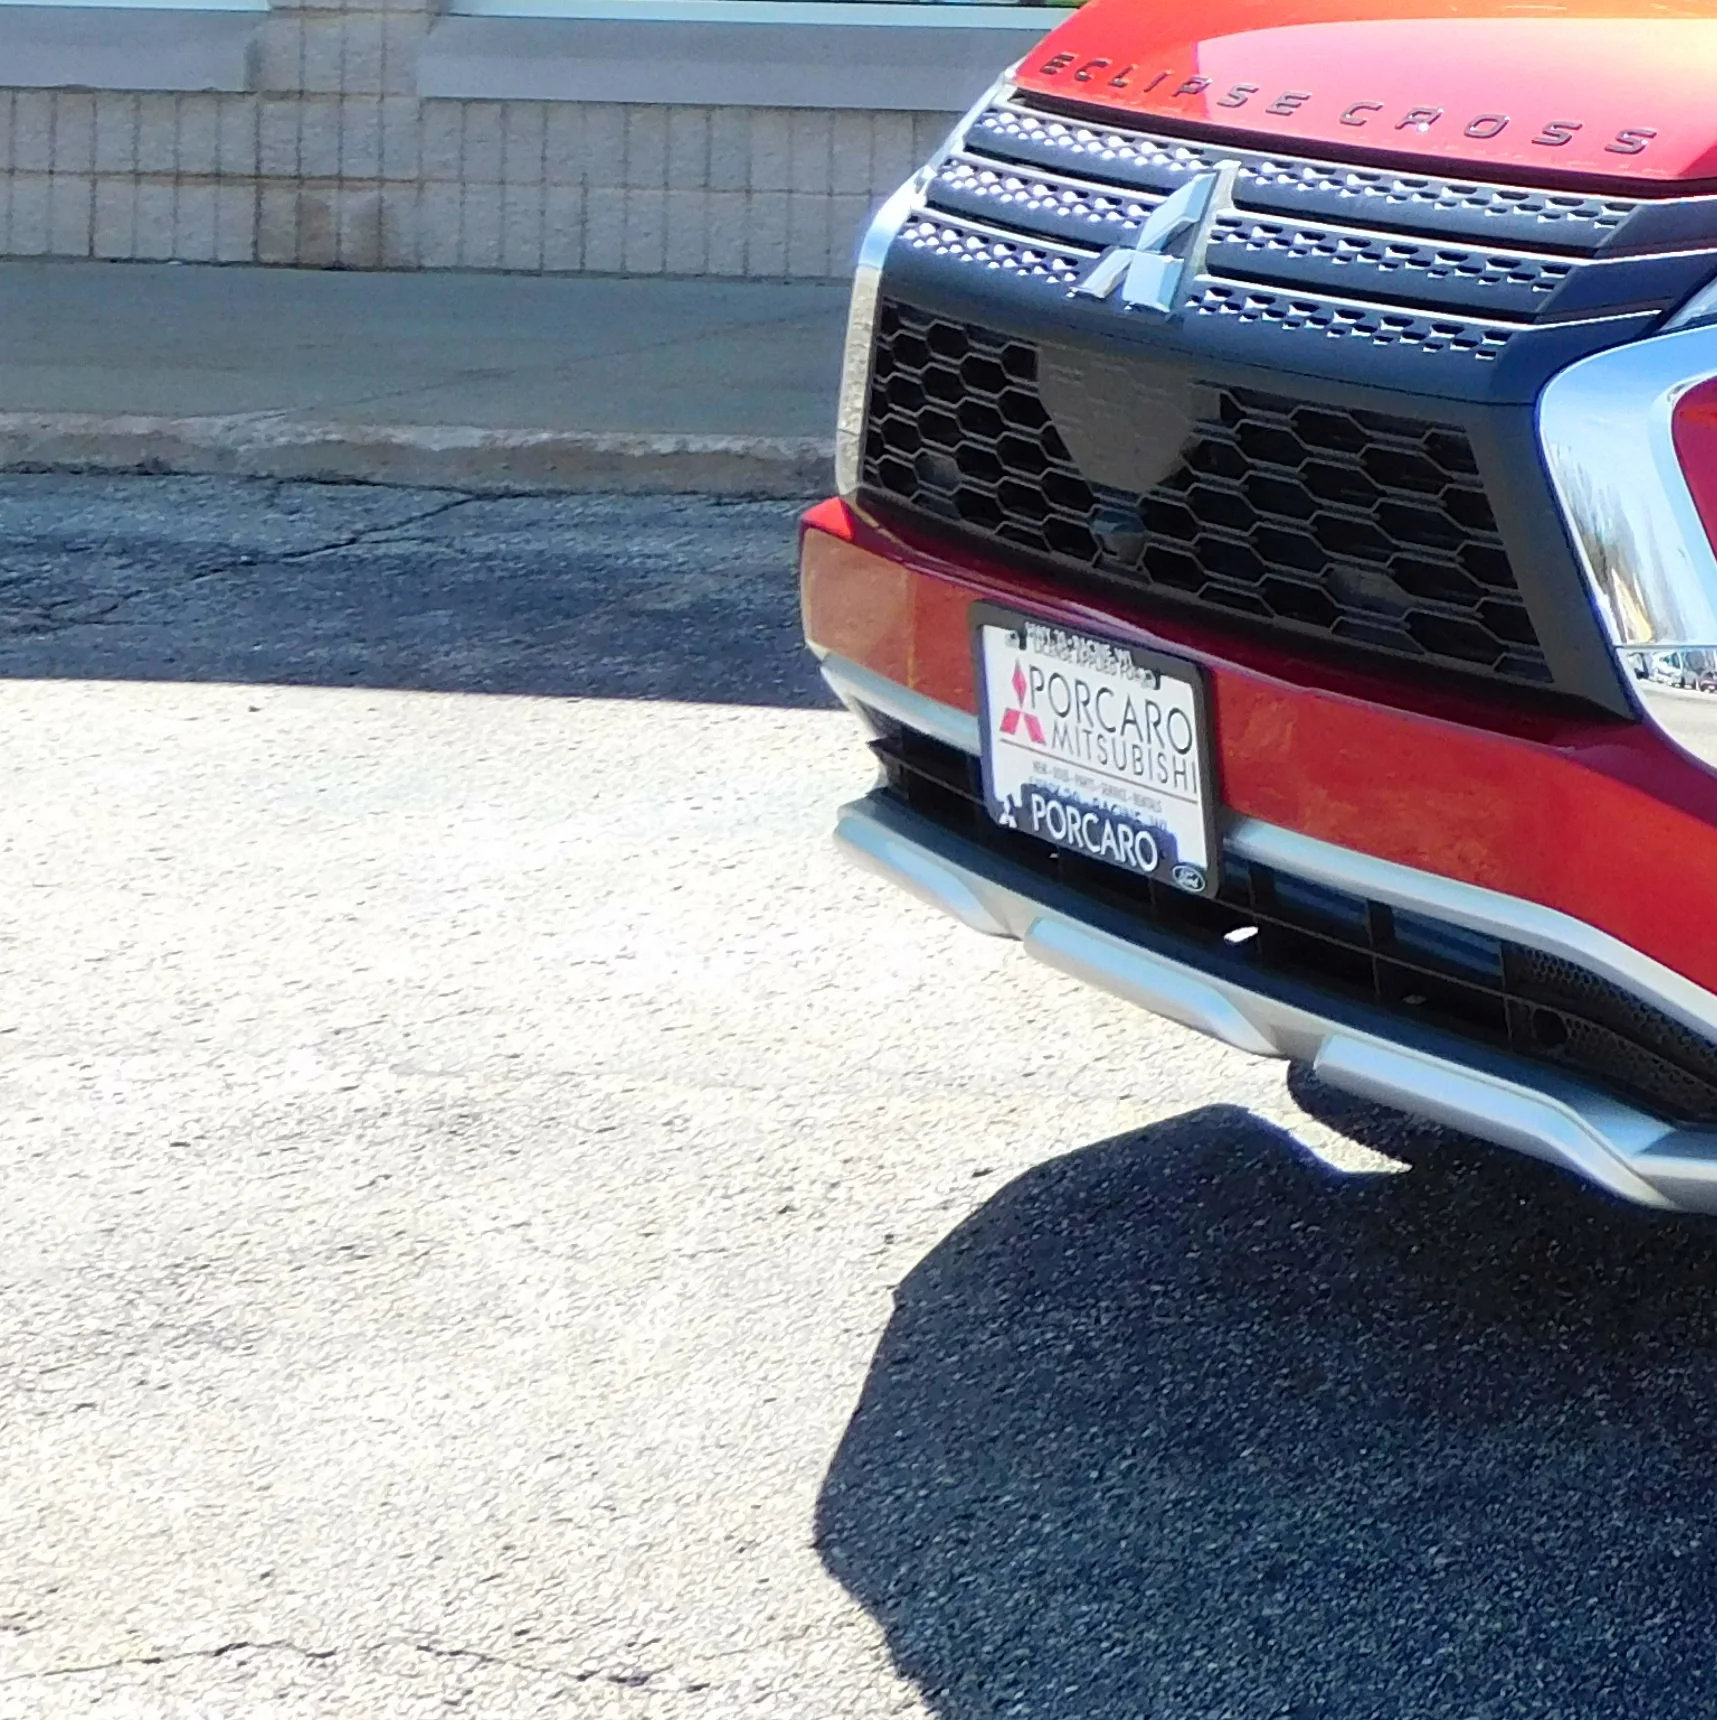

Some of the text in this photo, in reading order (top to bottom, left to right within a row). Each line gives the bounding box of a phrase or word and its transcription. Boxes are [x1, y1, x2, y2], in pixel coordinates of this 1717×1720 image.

[1039, 52, 1659, 155] ECLIPSE CROSS
[1028, 664, 1193, 755] PORCARO
[1051, 723, 1198, 795] MITSUBISHI
[1031, 793, 1159, 873] PORCARO
